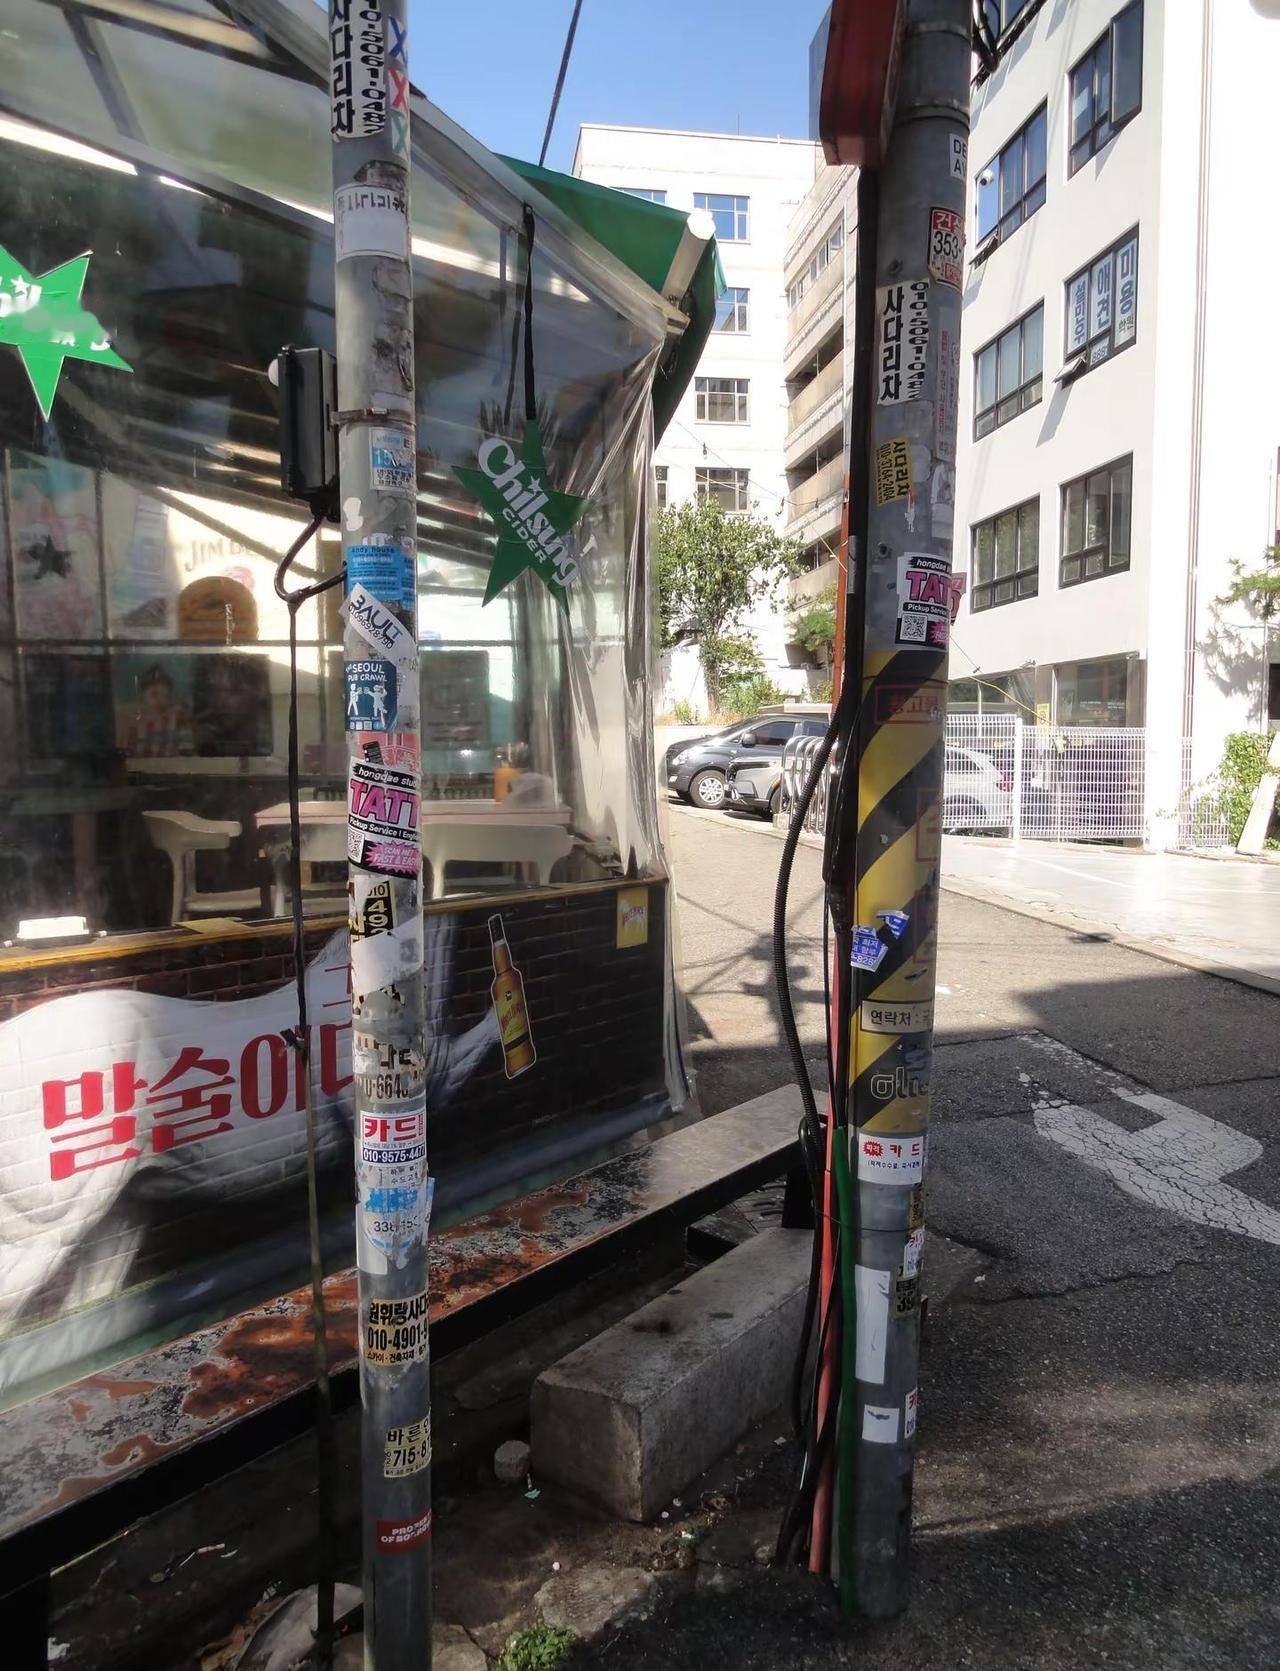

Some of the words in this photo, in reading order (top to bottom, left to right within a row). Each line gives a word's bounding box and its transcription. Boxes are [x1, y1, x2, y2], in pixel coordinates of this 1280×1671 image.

[330, 0, 355, 134] 사다리차
[1120, 244, 1135, 314] 미용
[881, 286, 905, 401] 사다리차
[478, 437, 580, 587] Chilsung
[502, 507, 548, 564] CIDER
[352, 662, 385, 674] SEOUL
[360, 673, 387, 681] CRAWL
[358, 766, 399, 784] hongdae
[368, 821, 397, 836] Service
[871, 1009, 911, 1026] 연락처
[364, 1117, 416, 1142] 카드
